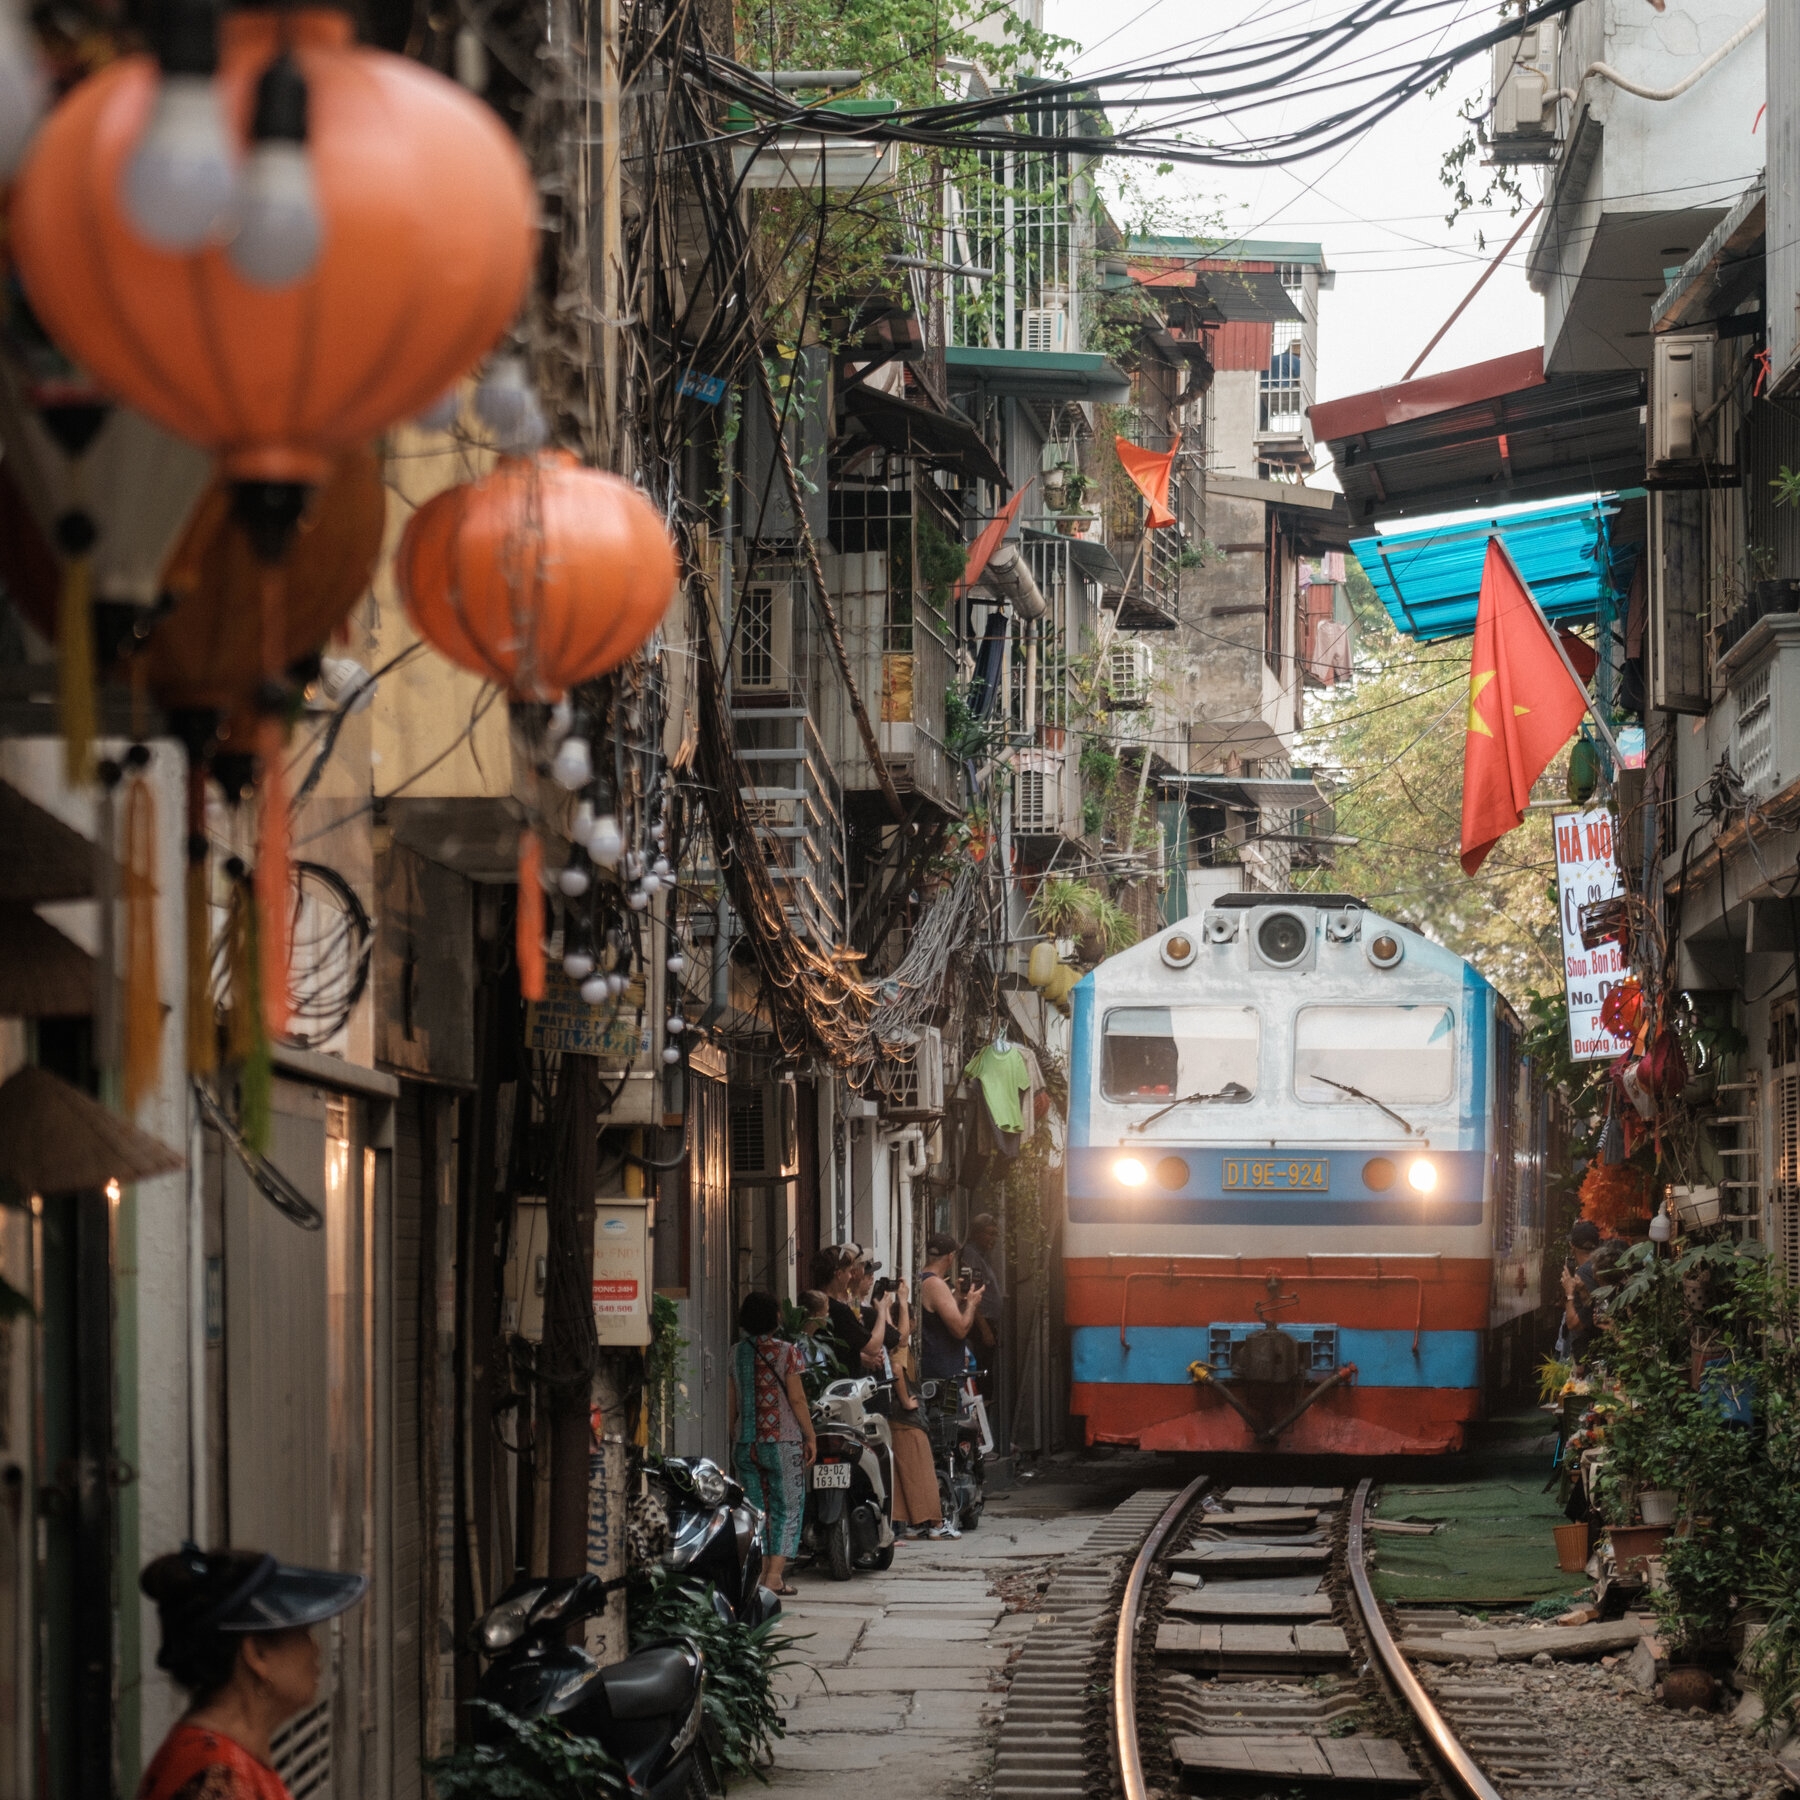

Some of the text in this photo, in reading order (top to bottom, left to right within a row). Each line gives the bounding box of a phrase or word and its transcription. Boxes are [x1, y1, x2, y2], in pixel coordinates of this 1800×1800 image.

[1558, 814, 1613, 868] HÀ NỘ
[1591, 951, 1609, 975] Bon
[1227, 1163, 1324, 1186] D19E-924
